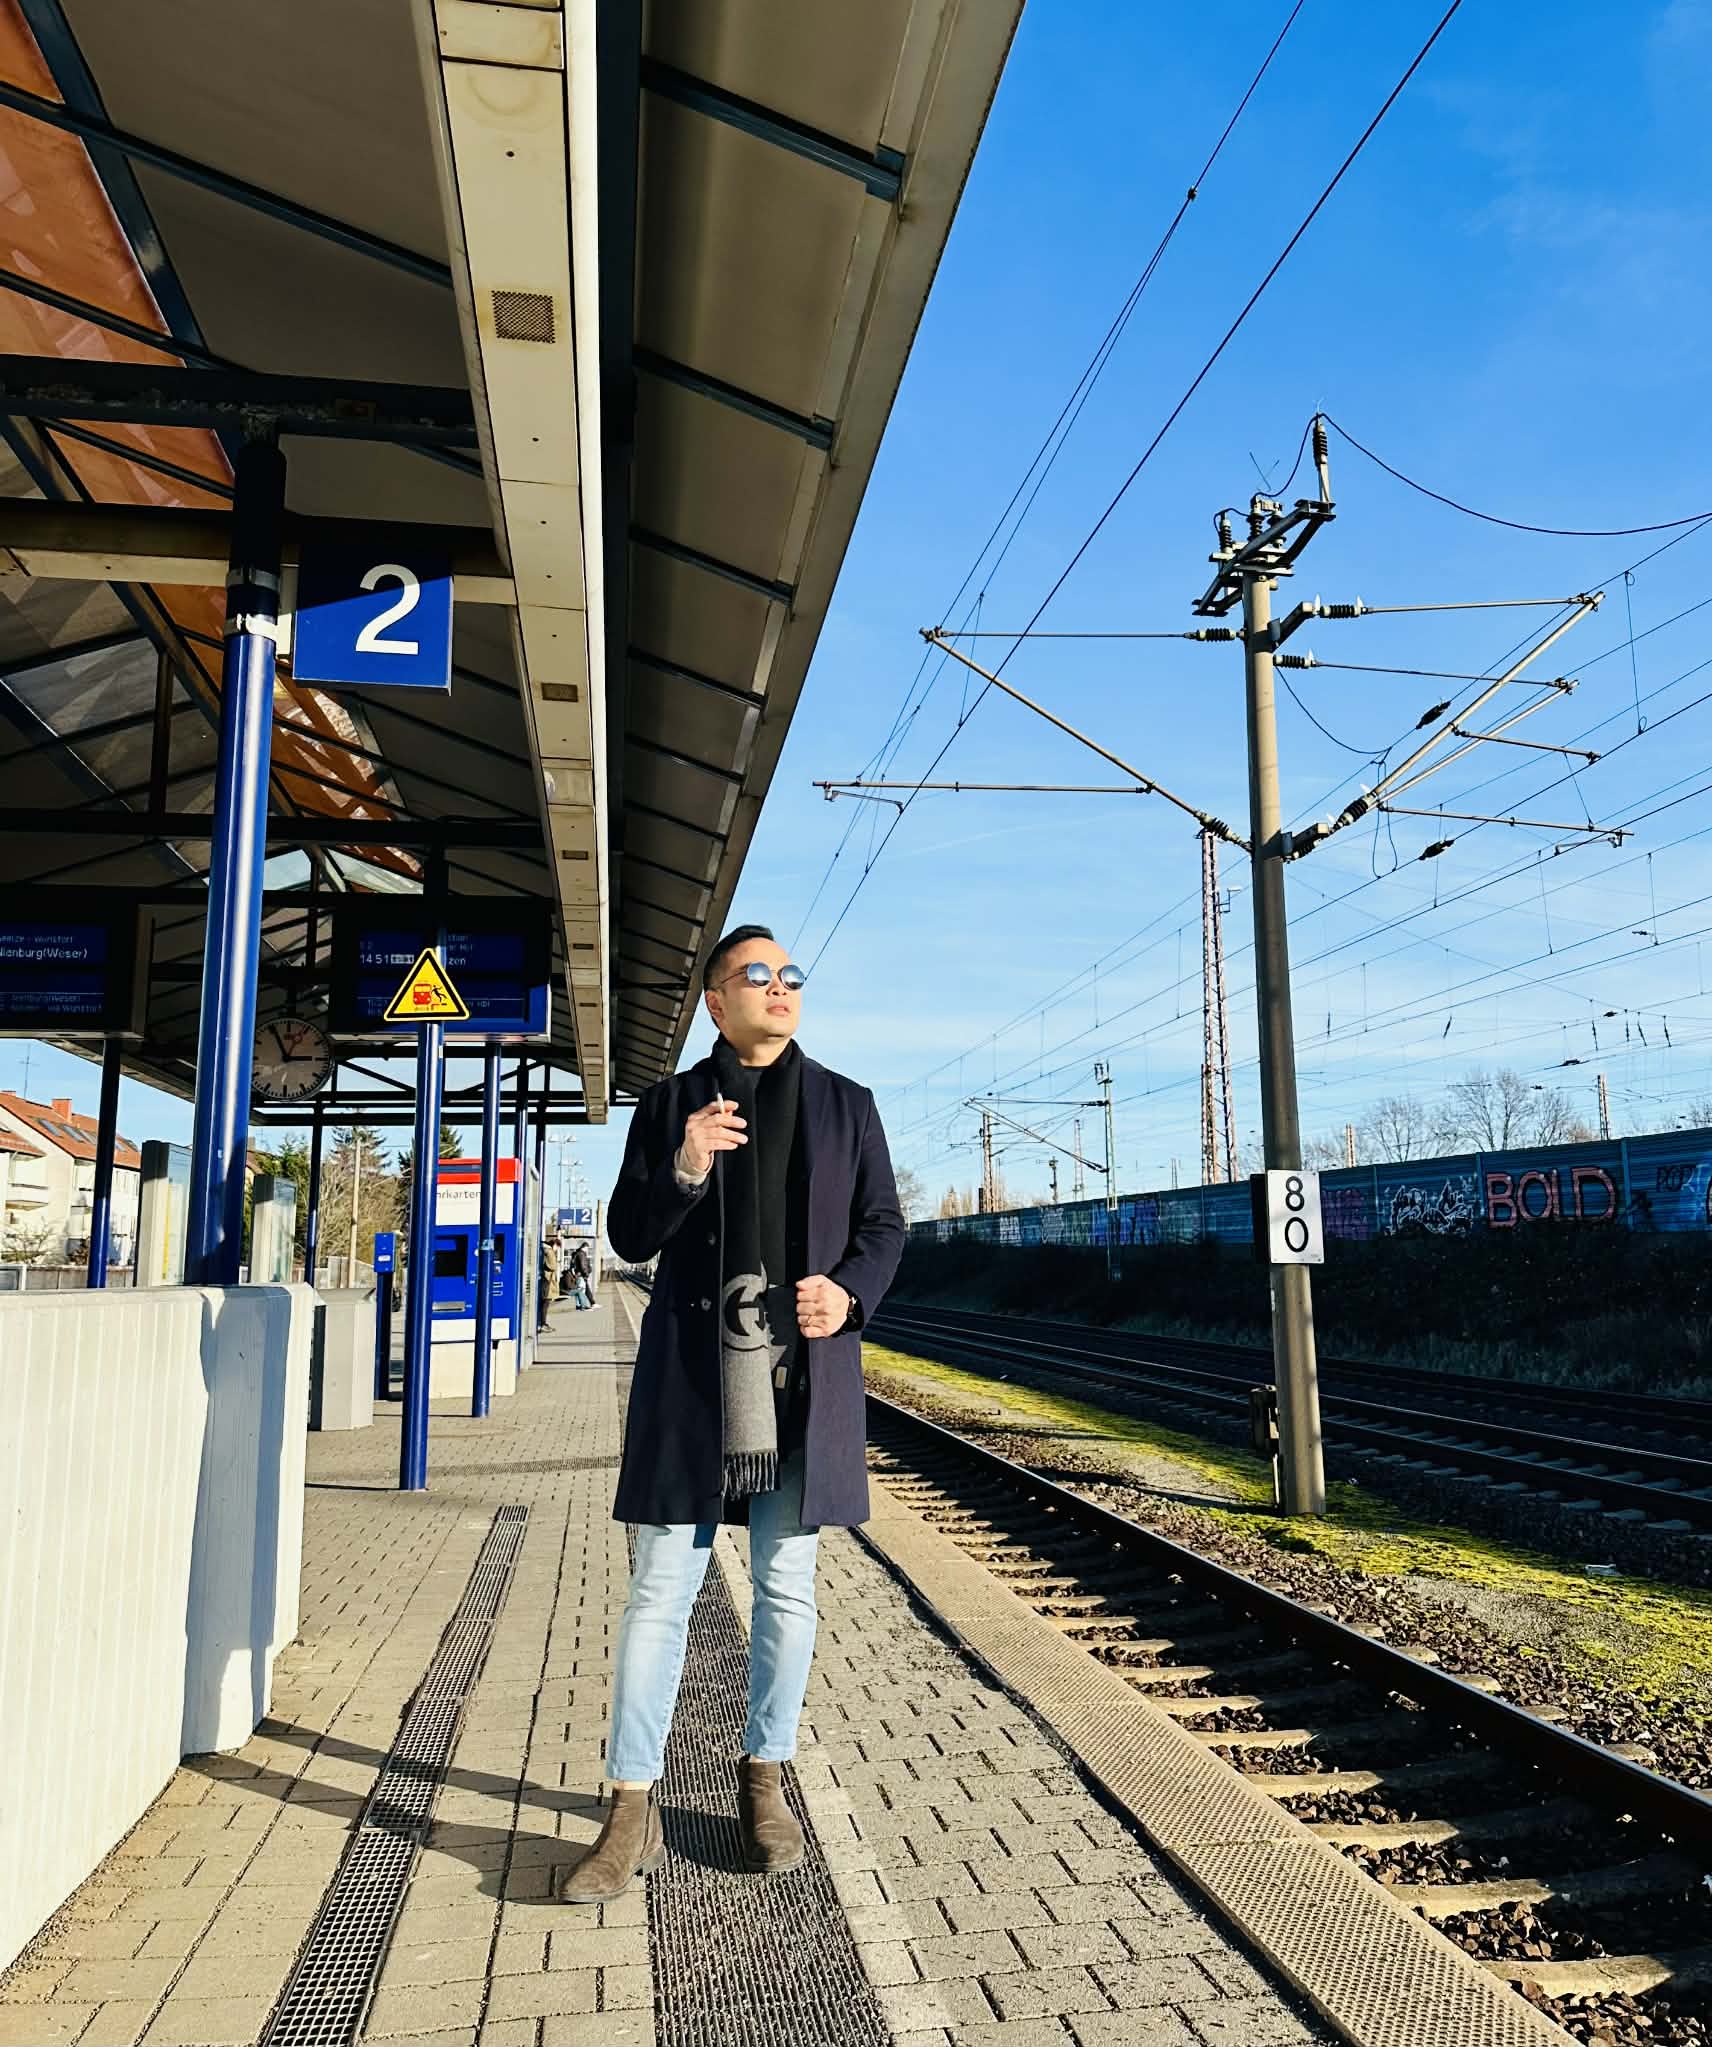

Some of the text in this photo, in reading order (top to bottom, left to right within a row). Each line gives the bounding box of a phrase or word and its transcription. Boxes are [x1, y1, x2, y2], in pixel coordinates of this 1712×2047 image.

[355, 563, 420, 655] 2
[1285, 1175, 1305, 1212] 8
[581, 1208, 591, 1223] 2
[1284, 1216, 1309, 1253] 0
